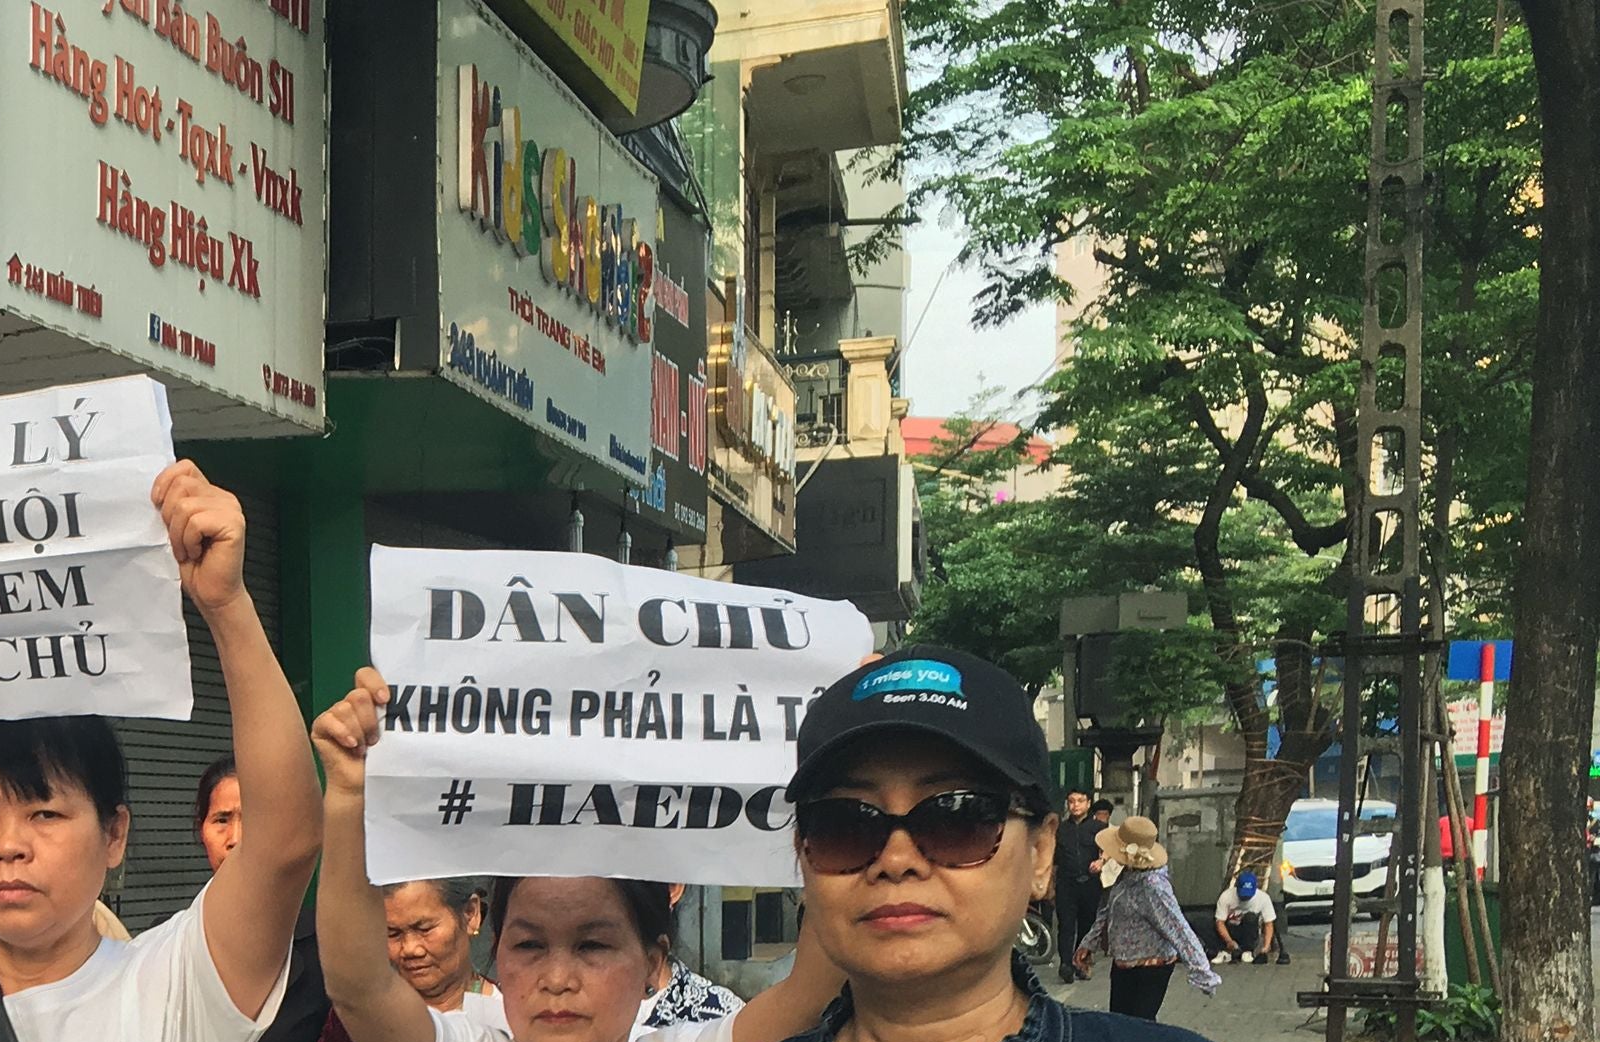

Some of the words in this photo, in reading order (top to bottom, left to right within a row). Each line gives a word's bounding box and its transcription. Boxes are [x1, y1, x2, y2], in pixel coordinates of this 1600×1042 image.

[205, 12, 263, 104] Buôn
[30, 1, 108, 126] Hàng
[114, 54, 161, 142] Hot
[176, 97, 234, 185] Tqxk
[250, 140, 303, 227] Vnxk
[96, 159, 166, 268] Hàng
[169, 200, 224, 292] Hiệu
[227, 230, 261, 298] Xk
[535, 306, 571, 350] TRANG
[9, 397, 101, 469] LÝ
[424, 574, 609, 643] DÂN
[637, 597, 811, 650] CHỦ
[385, 675, 552, 736] KHÔNG
[569, 670, 684, 741] PHẢI
[703, 684, 762, 742] LÀ
[917, 669, 950, 683] you
[947, 699, 968, 711] AM
[502, 783, 795, 832] HAEDC
